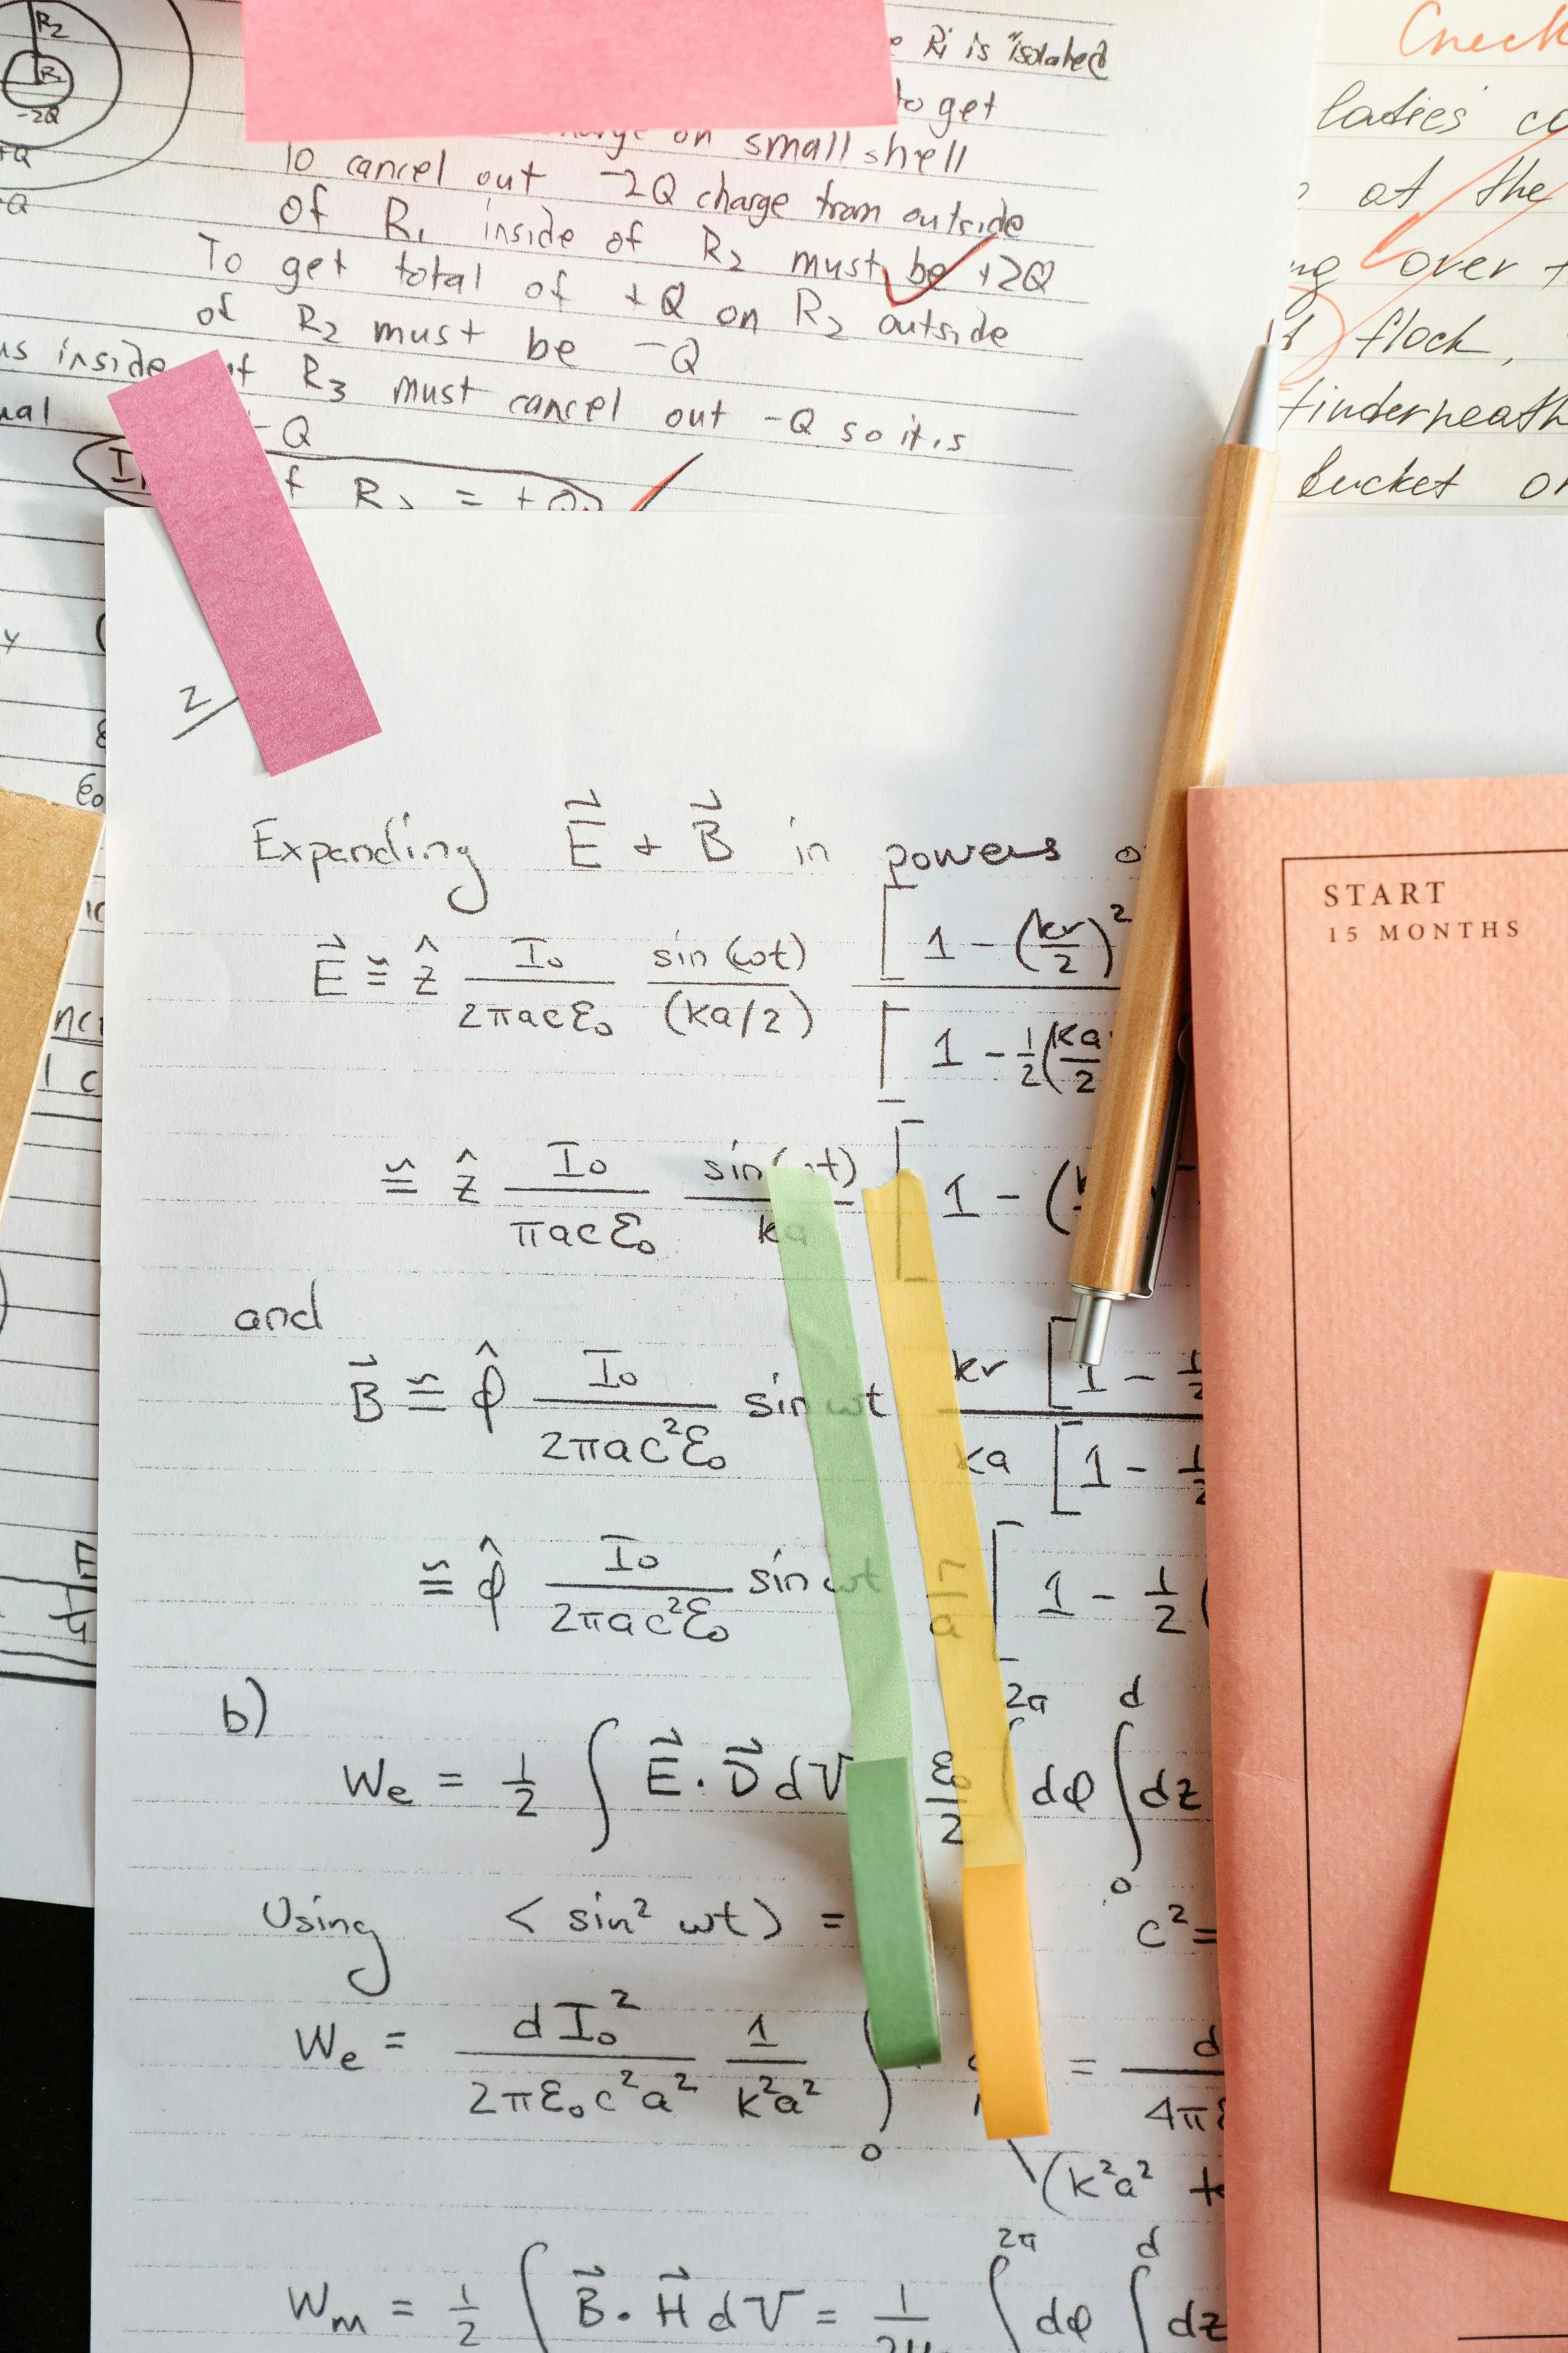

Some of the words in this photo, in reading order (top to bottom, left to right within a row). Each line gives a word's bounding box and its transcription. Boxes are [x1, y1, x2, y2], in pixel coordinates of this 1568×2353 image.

[928, 90, 997, 136] get
[744, 131, 851, 162] small
[347, 149, 447, 188] cancel
[477, 162, 546, 195] out
[696, 170, 790, 228] charge
[1475, 155, 1553, 206] the
[280, 184, 329, 231] of
[484, 198, 575, 249] inside
[606, 221, 644, 253] of
[792, 248, 888, 278] must
[1400, 251, 1519, 280] over
[274, 248, 347, 295] get
[395, 250, 482, 294] total
[524, 269, 574, 312] of
[716, 303, 759, 331] on
[878, 311, 1010, 348] outside
[196, 291, 237, 326] of
[373, 318, 486, 346] must
[526, 325, 578, 368] be
[508, 386, 622, 423] cancel
[665, 399, 728, 429] out
[253, 812, 489, 914] Expanding
[789, 816, 830, 866] in
[885, 836, 1061, 889] powers
[1323, 881, 1446, 908] START
[1329, 926, 1358, 943] 15
[1380, 920, 1519, 941] MONTHS
[235, 1278, 323, 1332] and
[749, 1548, 807, 1595] sin
[262, 1895, 391, 1997] Using
